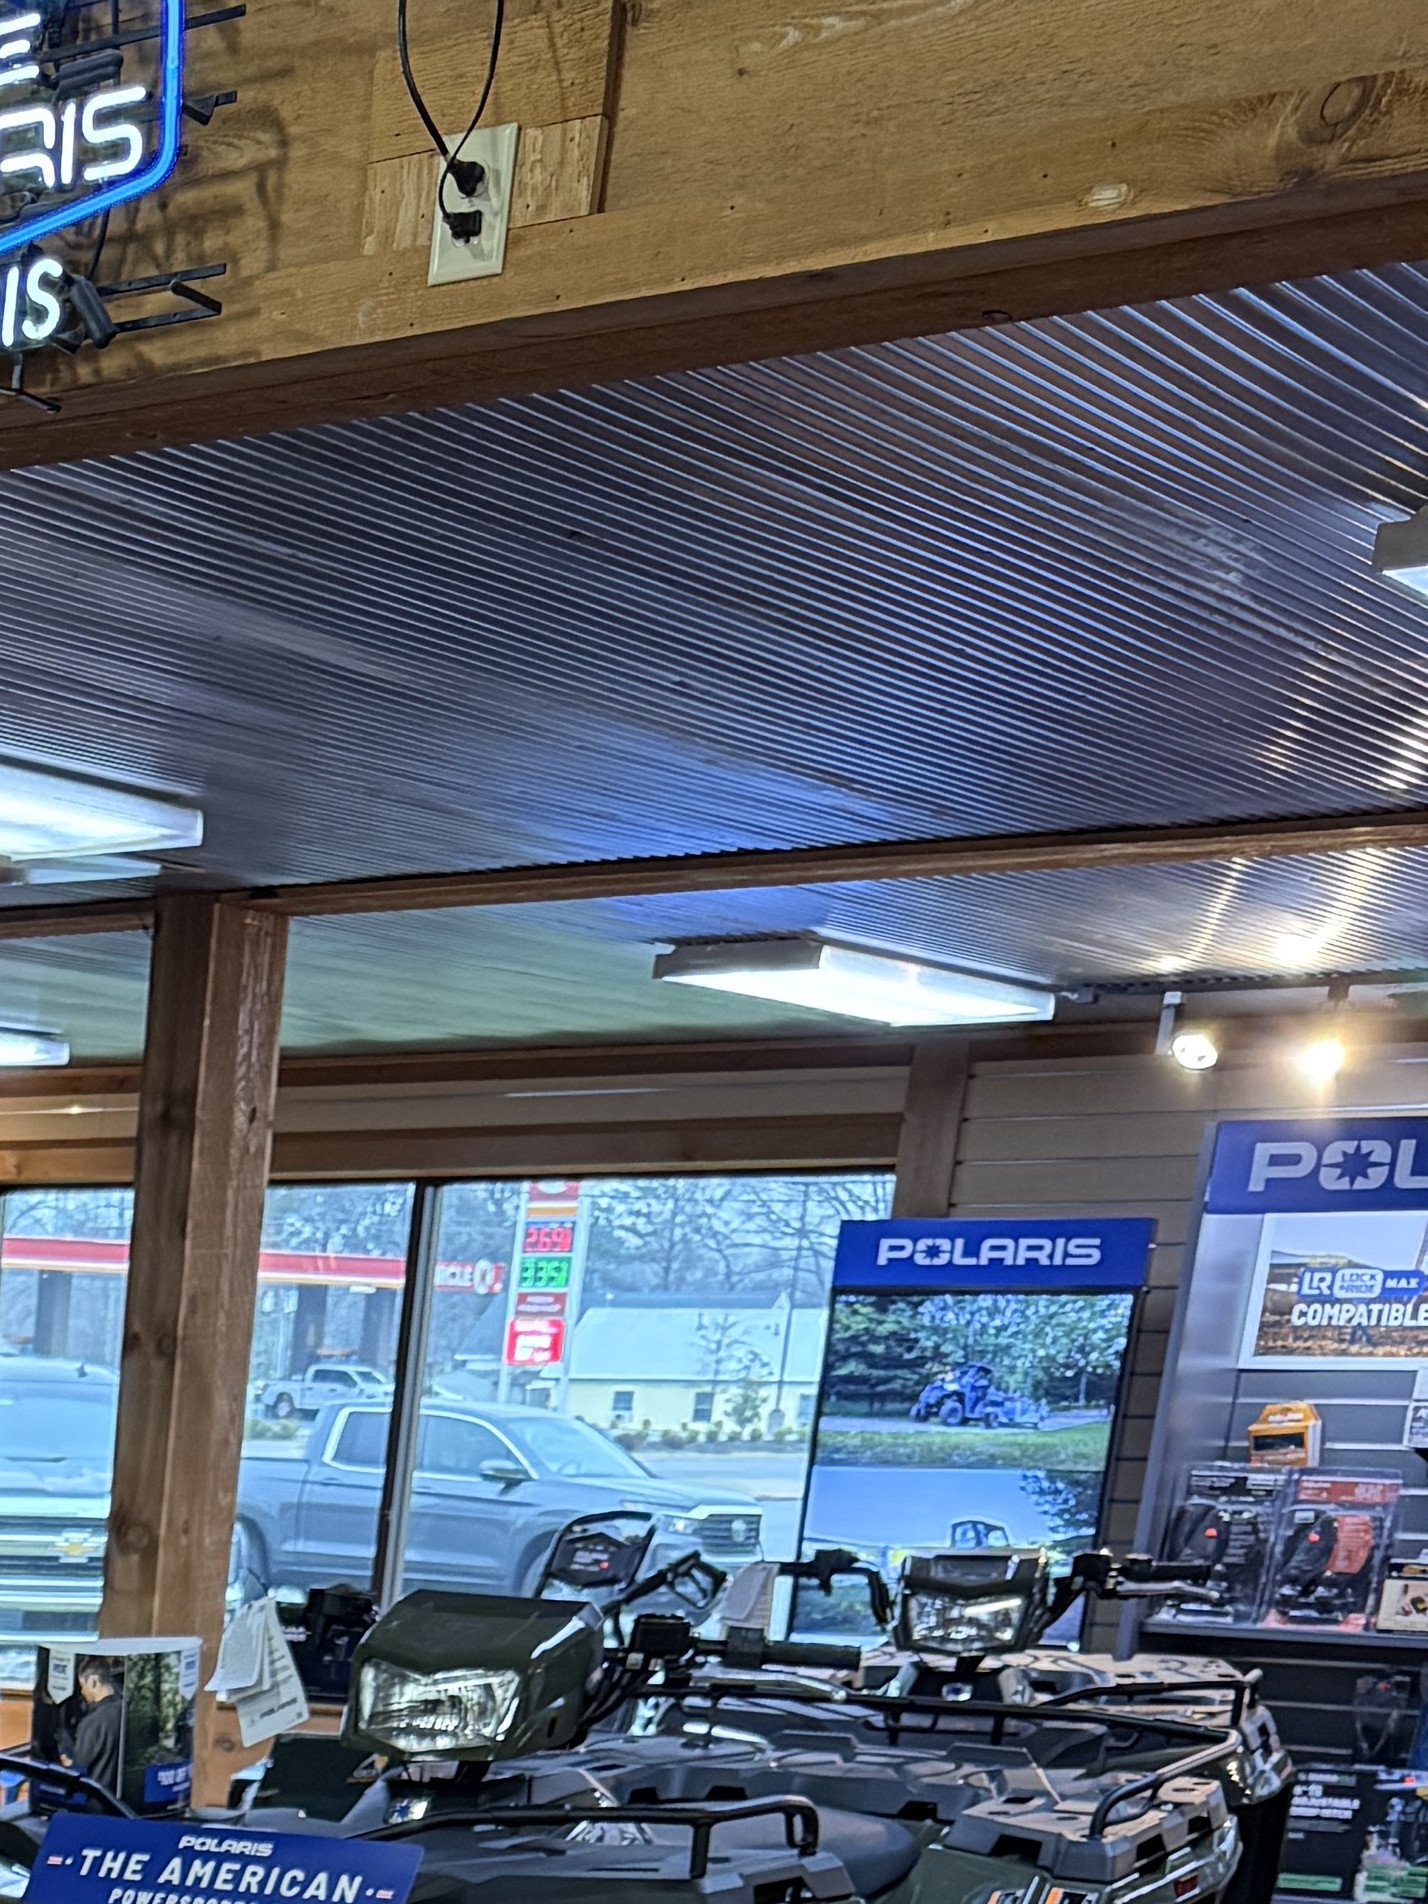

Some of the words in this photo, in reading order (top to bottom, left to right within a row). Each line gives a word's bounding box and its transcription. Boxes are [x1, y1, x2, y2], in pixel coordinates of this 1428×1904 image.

[876, 1236, 1102, 1267] POLARIS
[1290, 1302, 1428, 1327] COMPATIBLE
[178, 1834, 274, 1857] POLARIS
[79, 1848, 150, 1882] THE
[157, 1856, 363, 1904] AMERICAN
